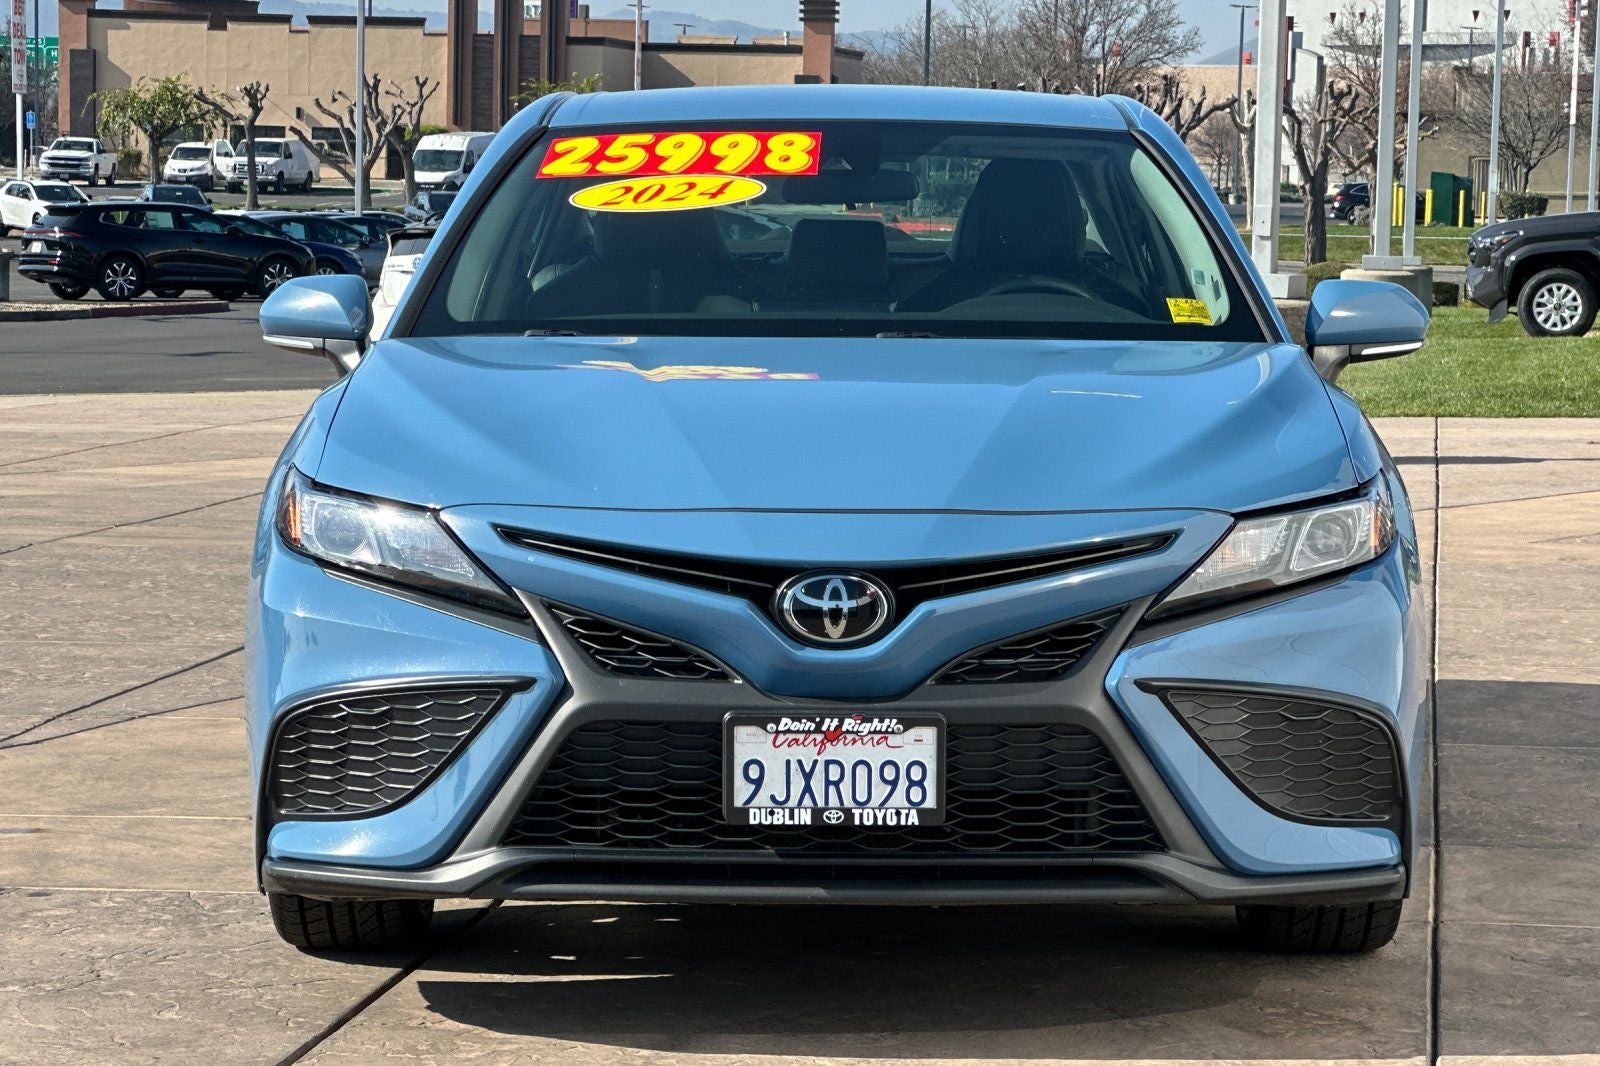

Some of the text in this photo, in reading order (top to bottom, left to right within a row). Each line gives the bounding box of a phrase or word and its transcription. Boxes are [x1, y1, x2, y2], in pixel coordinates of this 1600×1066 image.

[541, 133, 816, 176] 25998
[597, 180, 736, 207] 2024
[778, 717, 898, 736] Doin' It Right!
[772, 732, 904, 756] California
[742, 758, 928, 808] 9JXR098
[749, 808, 919, 826] DUBLIN TOYOTA
